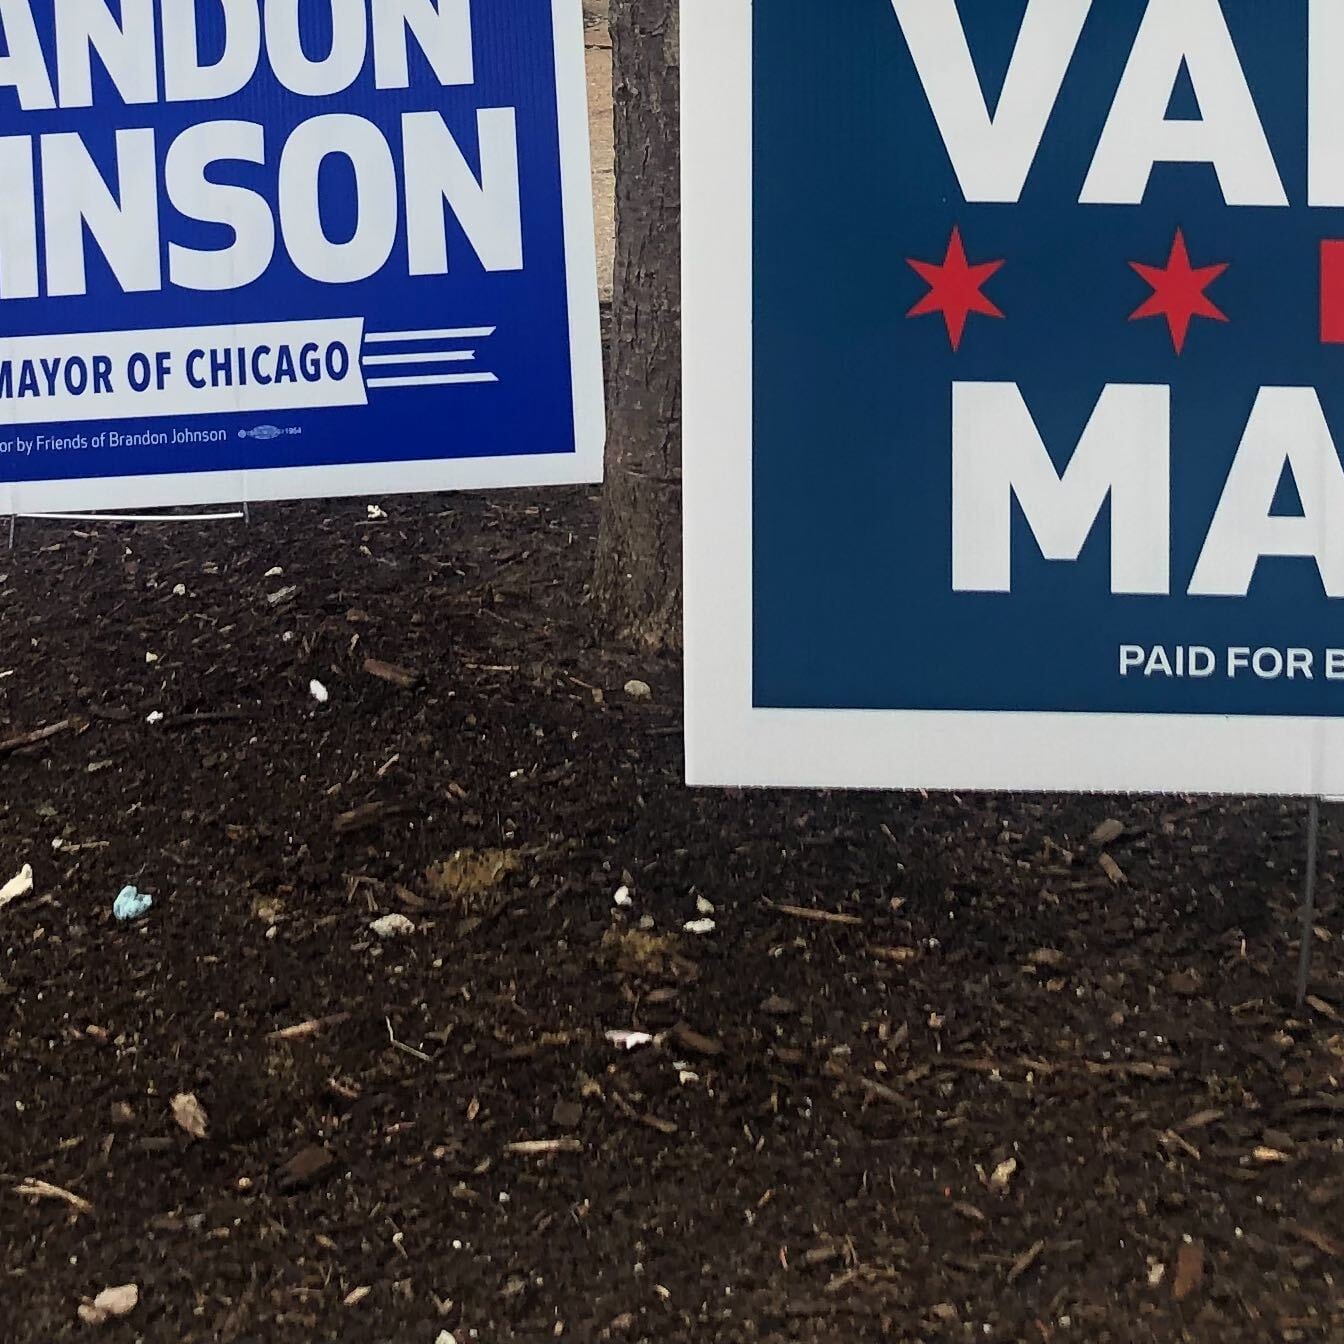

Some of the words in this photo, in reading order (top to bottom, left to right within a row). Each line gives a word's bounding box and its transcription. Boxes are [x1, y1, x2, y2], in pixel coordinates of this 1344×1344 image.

[127, 351, 171, 393] OF
[185, 341, 349, 389] CHICAGO
[16, 436, 33, 456] by
[36, 434, 88, 451] Friends
[91, 432, 106, 448] of
[109, 429, 168, 447] Brandon
[171, 428, 227, 444] Johnson
[1119, 645, 1216, 676] PAID
[1227, 647, 1313, 678] FOR
